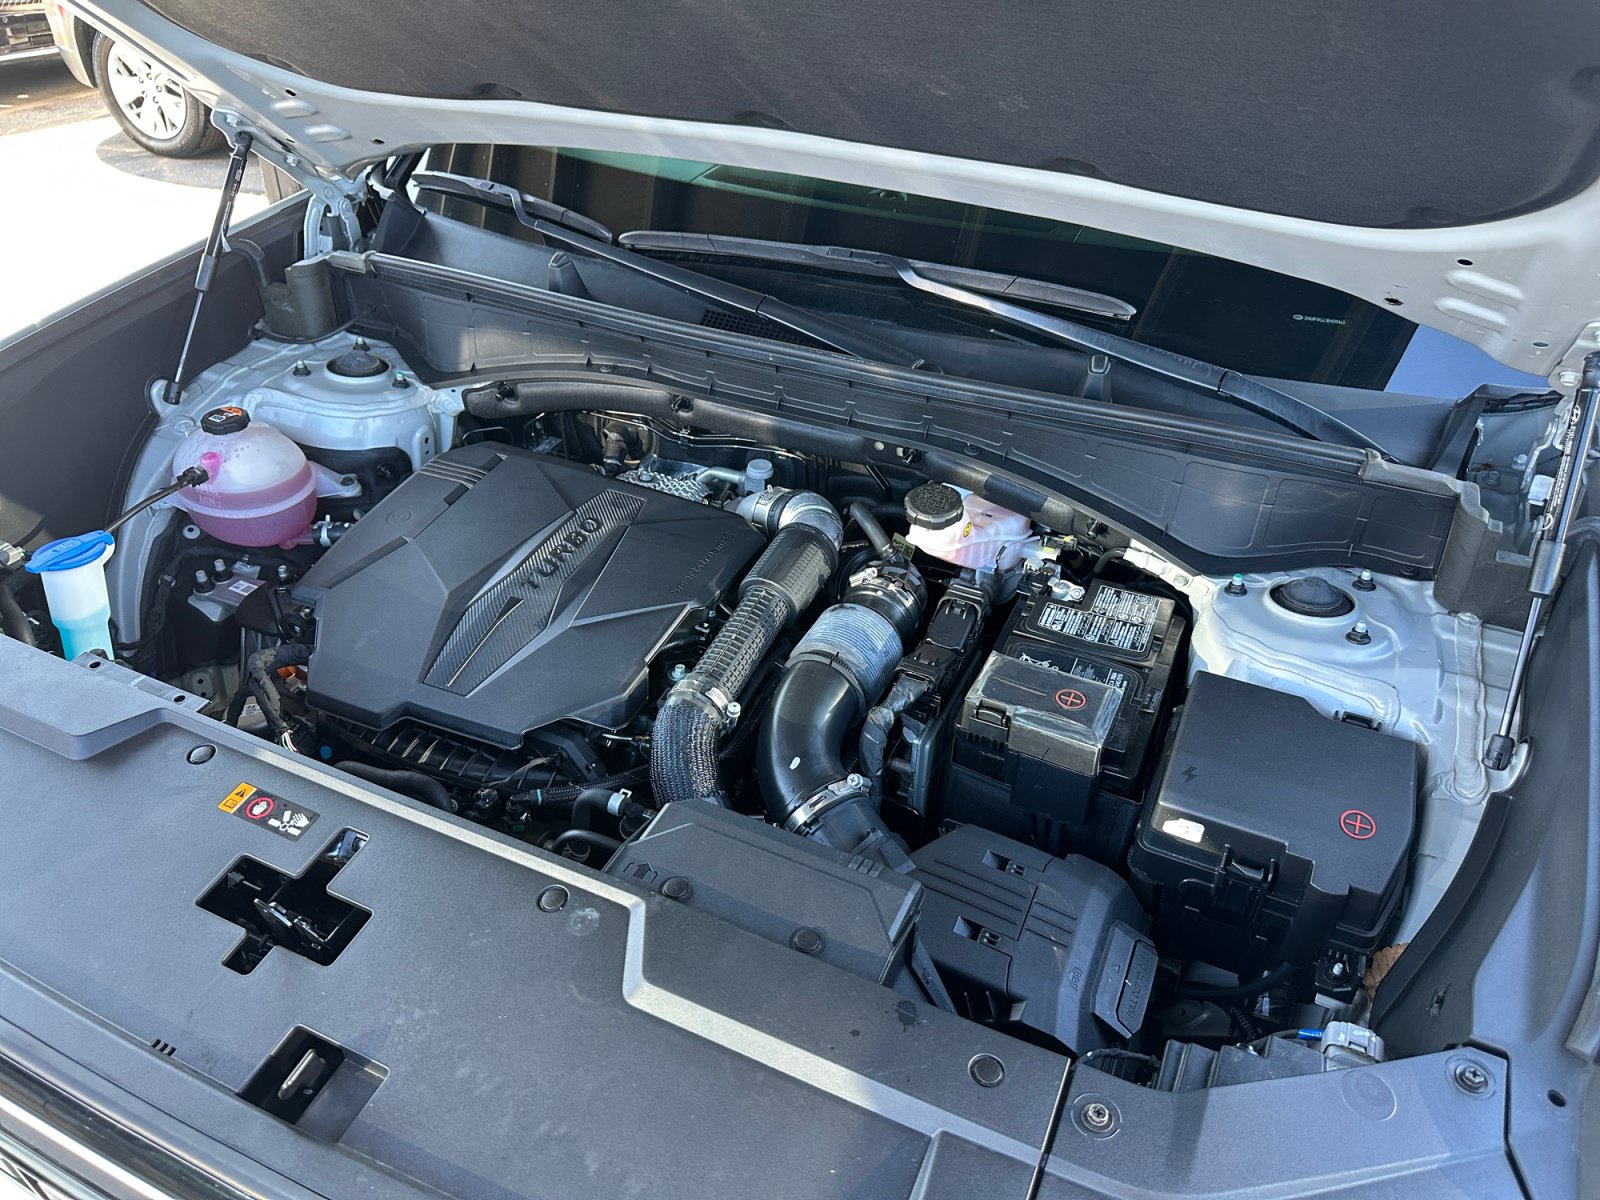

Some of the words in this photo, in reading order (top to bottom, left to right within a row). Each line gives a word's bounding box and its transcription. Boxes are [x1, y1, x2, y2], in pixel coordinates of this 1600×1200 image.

[520, 517, 601, 590] TURBO
[669, 540, 727, 593] Smartstream
[1126, 1000, 1138, 1019] PULL
